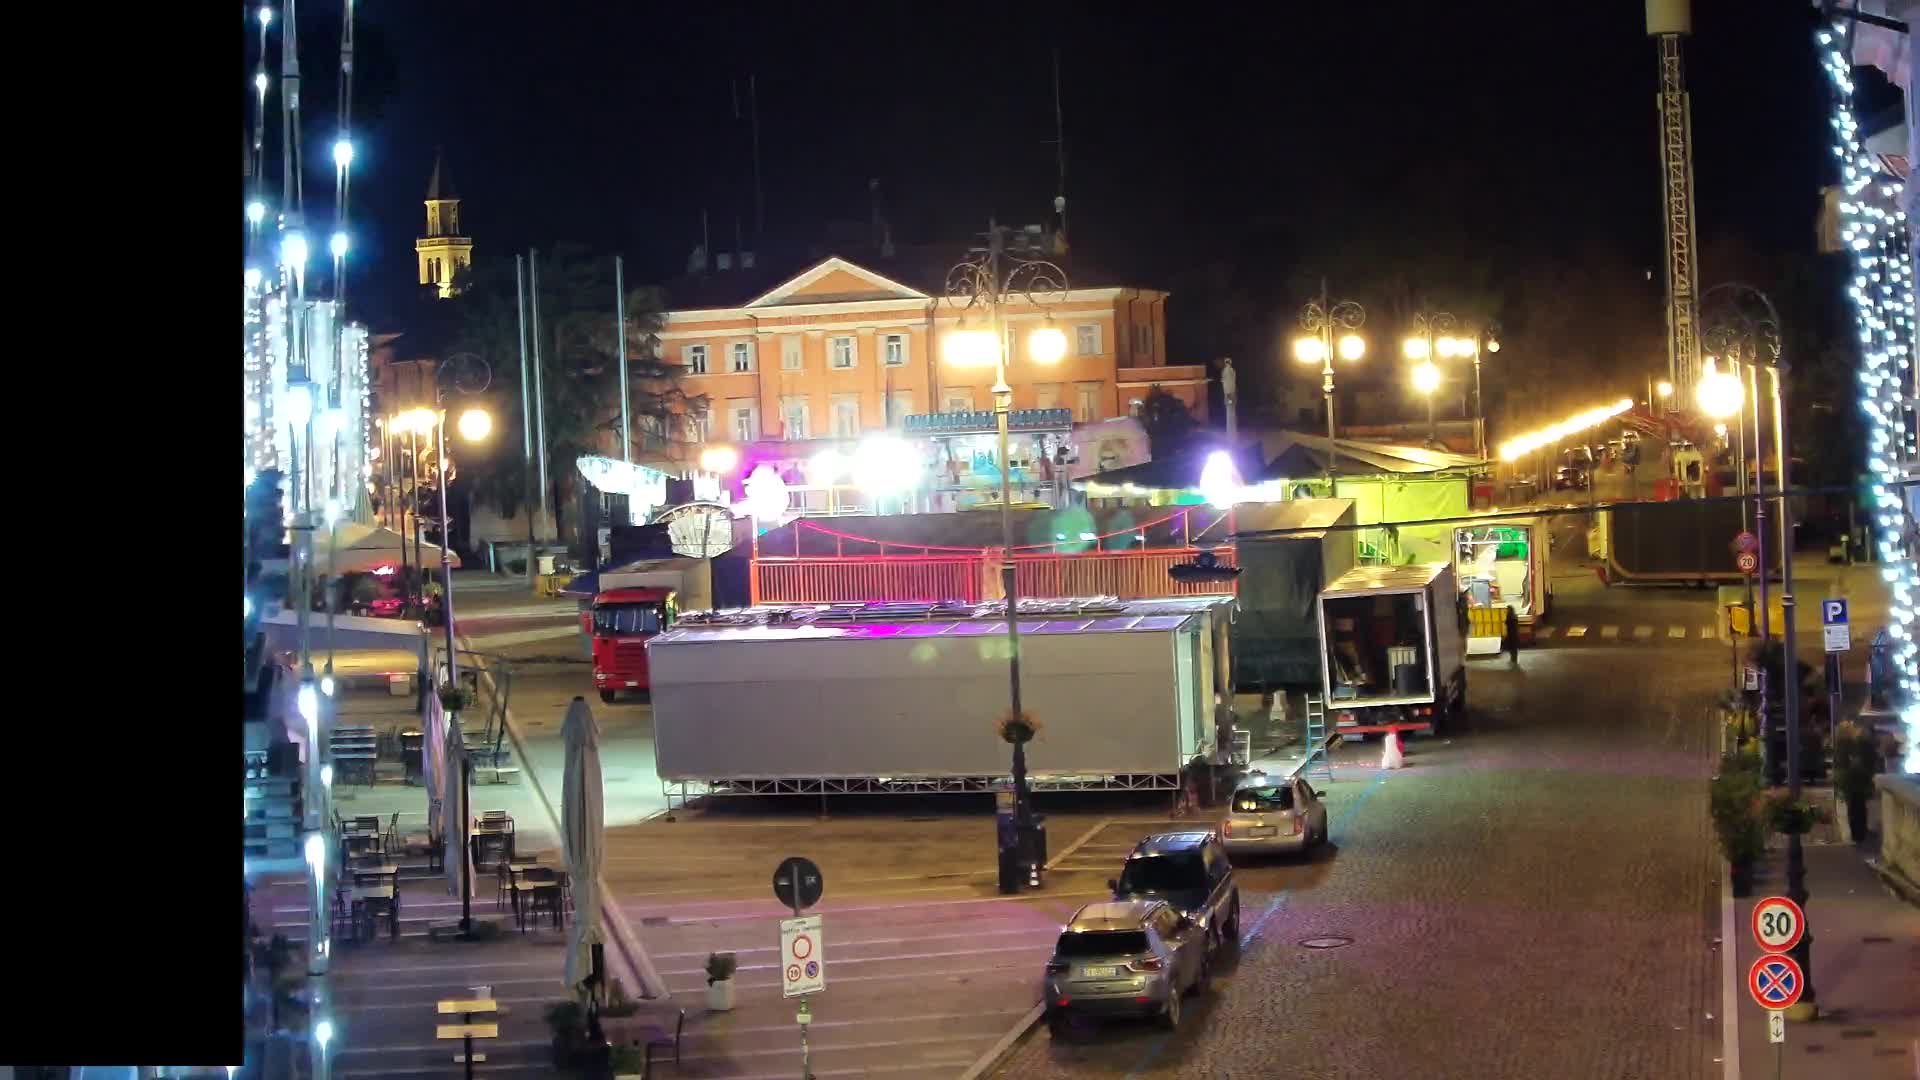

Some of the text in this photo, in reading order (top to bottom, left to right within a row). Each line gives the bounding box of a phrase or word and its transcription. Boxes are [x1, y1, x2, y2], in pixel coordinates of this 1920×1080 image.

[1742, 558, 1753, 567] 20
[1827, 602, 1842, 622] P
[1762, 912, 1791, 937] 30
